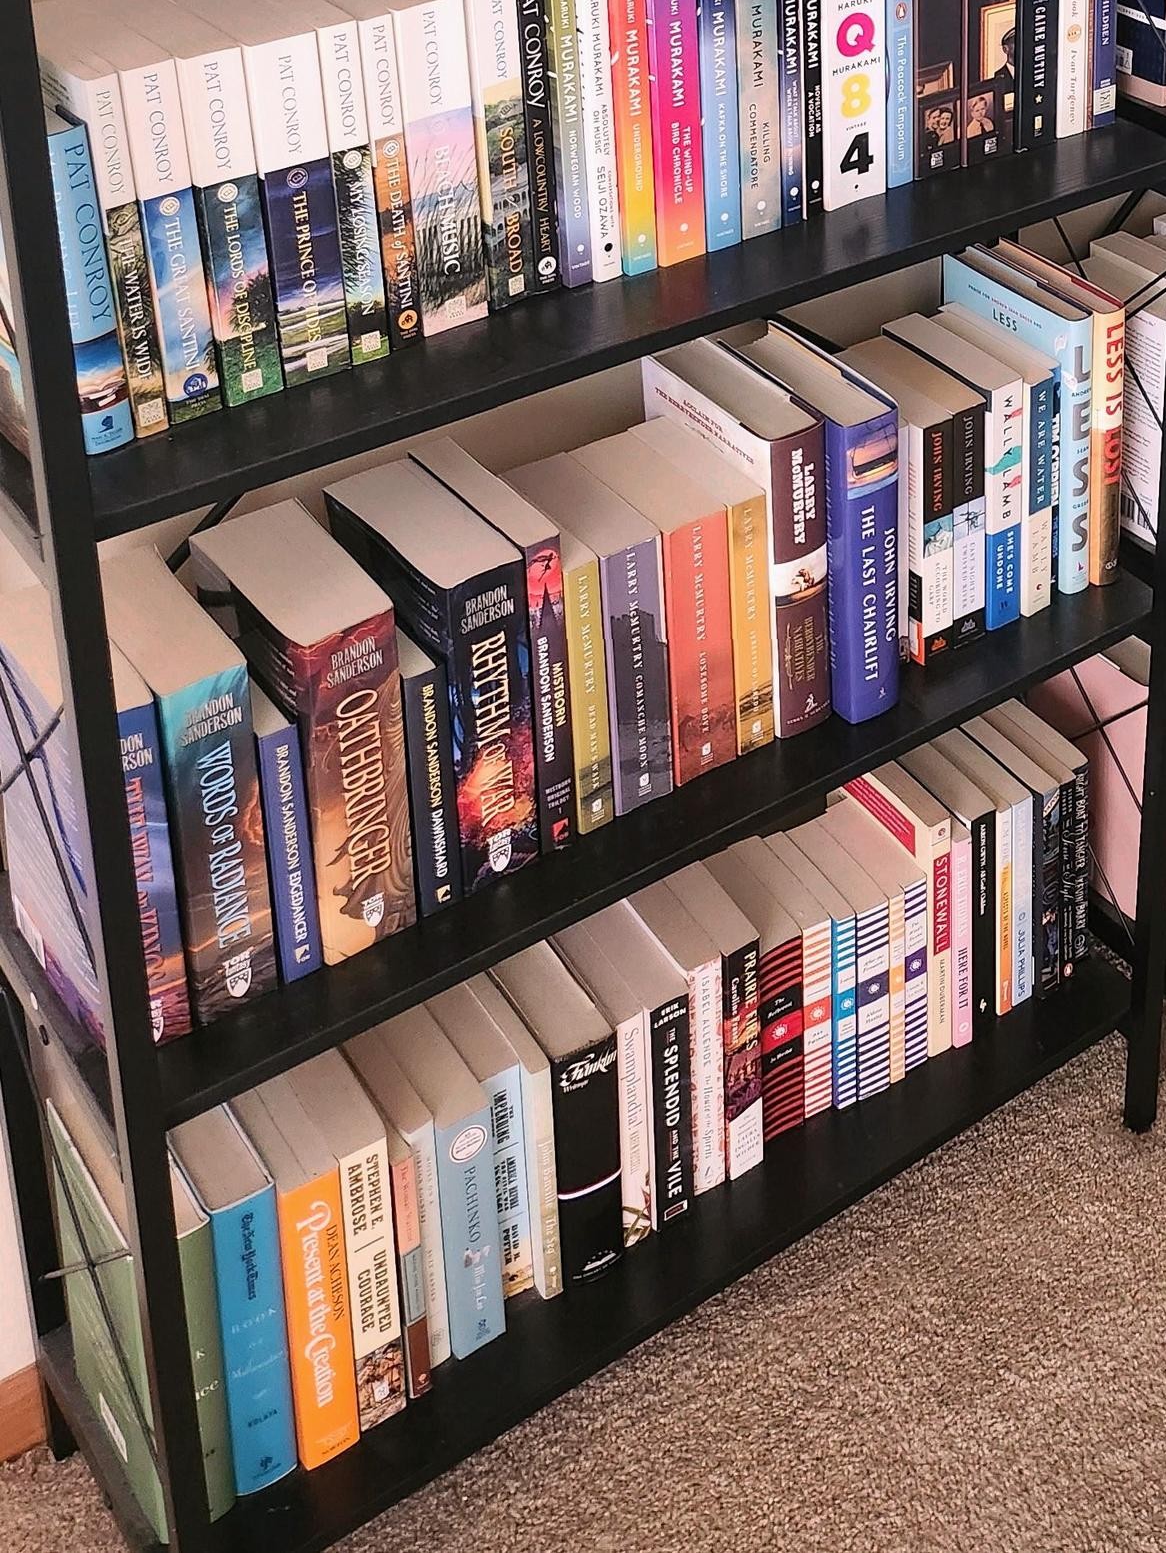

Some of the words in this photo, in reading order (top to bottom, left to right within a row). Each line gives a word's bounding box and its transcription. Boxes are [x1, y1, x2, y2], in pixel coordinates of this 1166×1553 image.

[836, 12, 876, 58] Q
[1035, 6, 1046, 44] CAINE
[525, 25, 546, 108] CONROY
[669, 20, 685, 108] MURAKAMI
[832, 56, 881, 76] MURAKAMI
[1034, 46, 1045, 89] MUTINY
[841, 71, 872, 119] 8
[64, 143, 89, 190] PAT
[841, 132, 874, 176] 4
[73, 202, 111, 324] CONROY
[992, 309, 1018, 332] LESS
[860, 505, 874, 541] THE
[862, 545, 876, 586] LAST
[884, 528, 897, 569] JOHN
[885, 577, 899, 643] IRVING
[331, 638, 376, 670] BRANDON
[862, 589, 879, 681] CHAIRLIFT
[326, 649, 384, 688] SANDERSON
[180, 709, 242, 747] SANDERSON
[184, 693, 234, 728] BRANDON
[198, 742, 237, 827] WORDS
[335, 688, 392, 888] OATHBRINGER
[212, 825, 233, 847] OF
[211, 838, 253, 948] RADIANCE
[934, 857, 951, 954] STONEWALL
[653, 1007, 686, 1028] LARSON
[660, 1002, 680, 1017] ERIK
[664, 1045, 681, 1127] SPLENDID
[348, 1163, 367, 1236] AMBROSE
[366, 1154, 381, 1215] STEPHEN
[667, 1166, 682, 1199] VILE
[358, 1269, 374, 1333] COURAGE
[374, 1249, 392, 1334] UNDAUNTED
